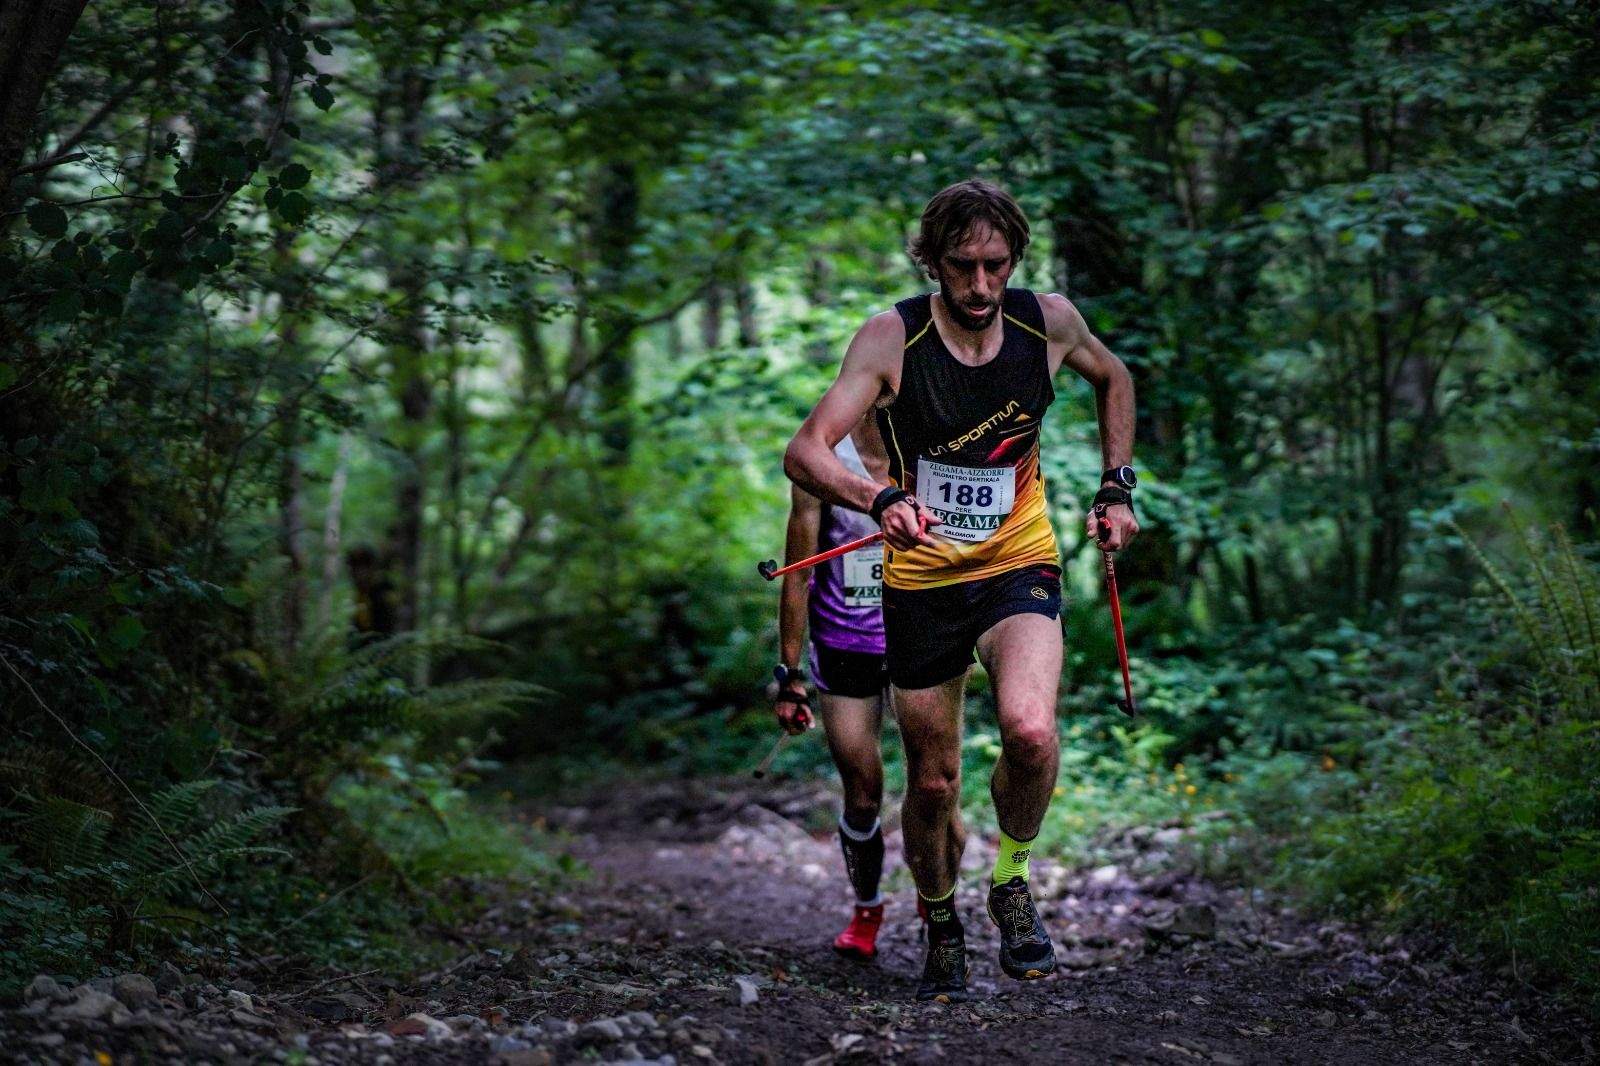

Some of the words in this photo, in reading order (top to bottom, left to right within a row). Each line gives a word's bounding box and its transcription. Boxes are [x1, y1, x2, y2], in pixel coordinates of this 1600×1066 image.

[928, 445, 947, 457] LA
[948, 400, 1020, 452] SPORTIVA
[929, 462, 1005, 476] ZEGAMA-AIZKORRI
[932, 471, 968, 481] KILOMETRO
[939, 481, 993, 507] 188
[956, 506, 972, 514] PERE
[943, 529, 976, 539] SALOMON
